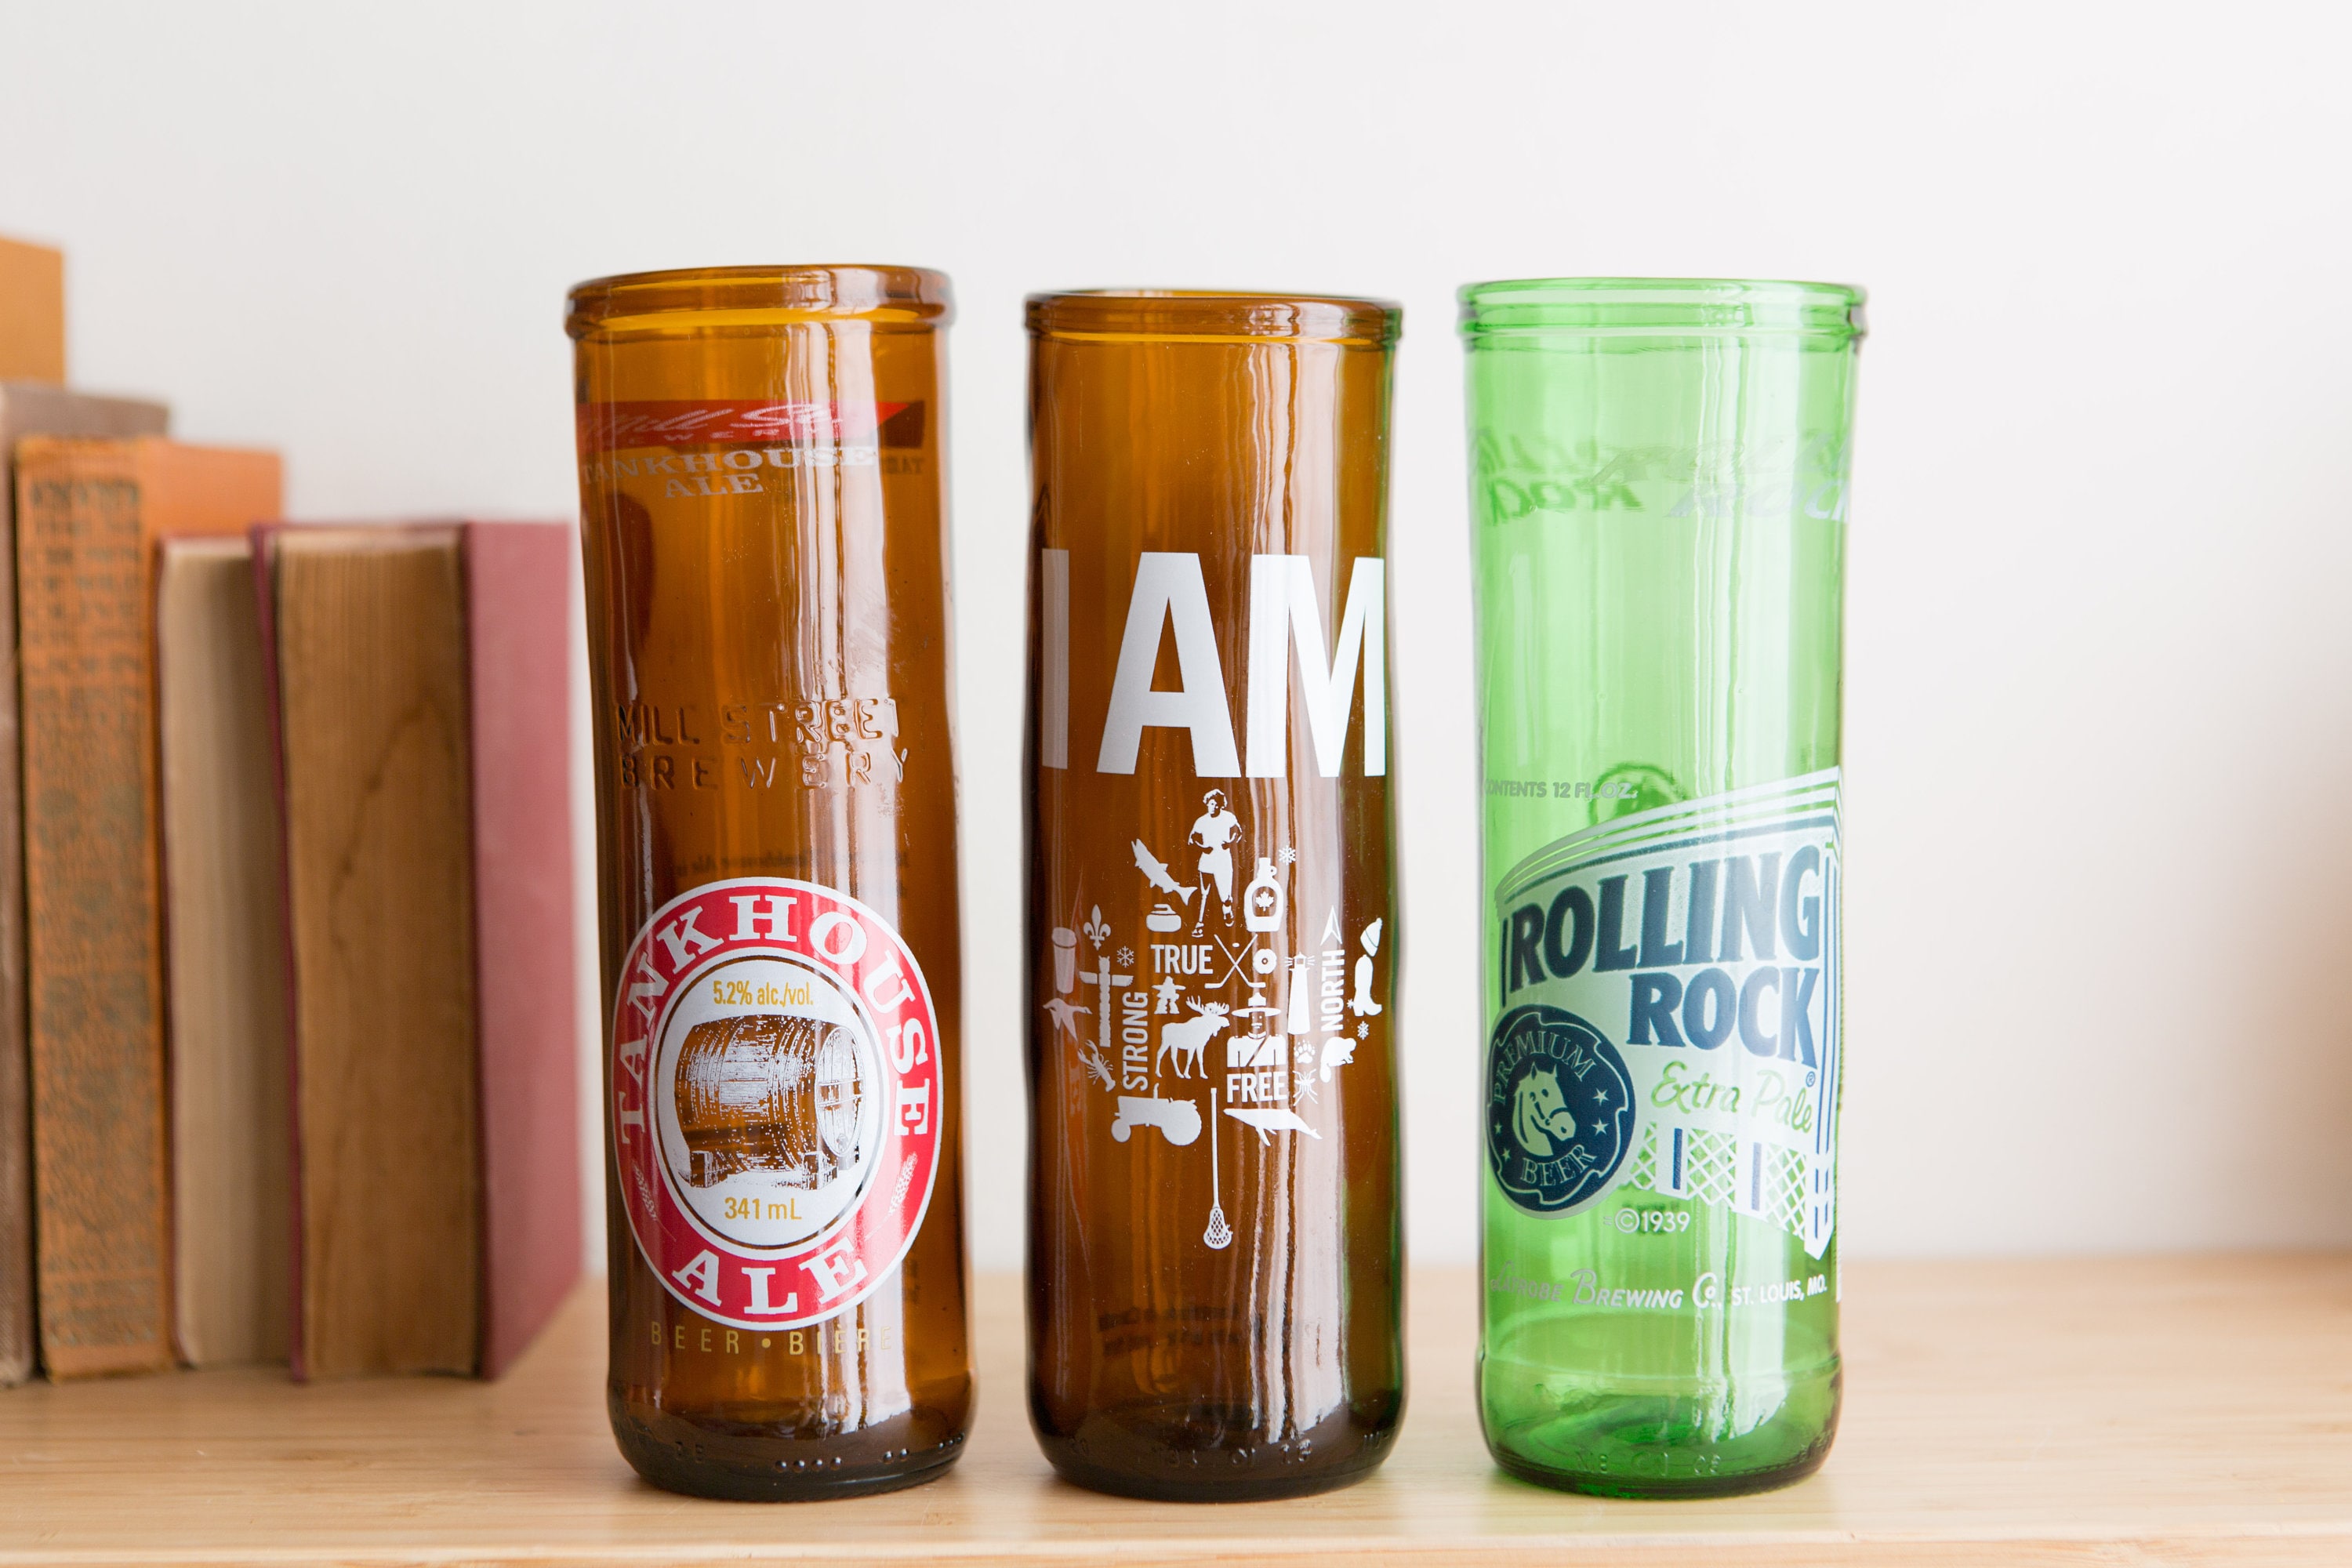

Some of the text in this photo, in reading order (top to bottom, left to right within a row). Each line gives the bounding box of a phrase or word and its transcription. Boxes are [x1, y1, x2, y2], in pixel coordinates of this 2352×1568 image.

[664, 473, 764, 499] ALE
[1042, 549, 1386, 779] I AM
[615, 697, 900, 745] MILL STREET
[619, 747, 909, 789] BREWERY
[1552, 782, 1571, 798] 12
[1510, 844, 1820, 993] ROLLING
[1150, 944, 1214, 975] TRUE
[713, 980, 753, 1005] 5.2%
[1321, 949, 1345, 1032] NORTH
[619, 894, 931, 1145] TANKHOUSE
[1627, 965, 1820, 1069] ROCK
[1122, 991, 1149, 1091] STRONG
[1226, 1070, 1288, 1103] FREE
[1493, 1030, 1596, 1105] PREMIUM
[1651, 1060, 1813, 1134] Extra Pale
[1519, 1144, 1597, 1187] BEER
[724, 1196, 802, 1221] 341 mL
[671, 1234, 869, 1315] ALE
[1570, 1268, 1684, 1309] BREWING
[1731, 1287, 1755, 1307] ST.
[1759, 1279, 1805, 1304] LOUIS,
[1807, 1273, 1828, 1297] MO.
[651, 1321, 892, 1356] BEER BIÈRE
